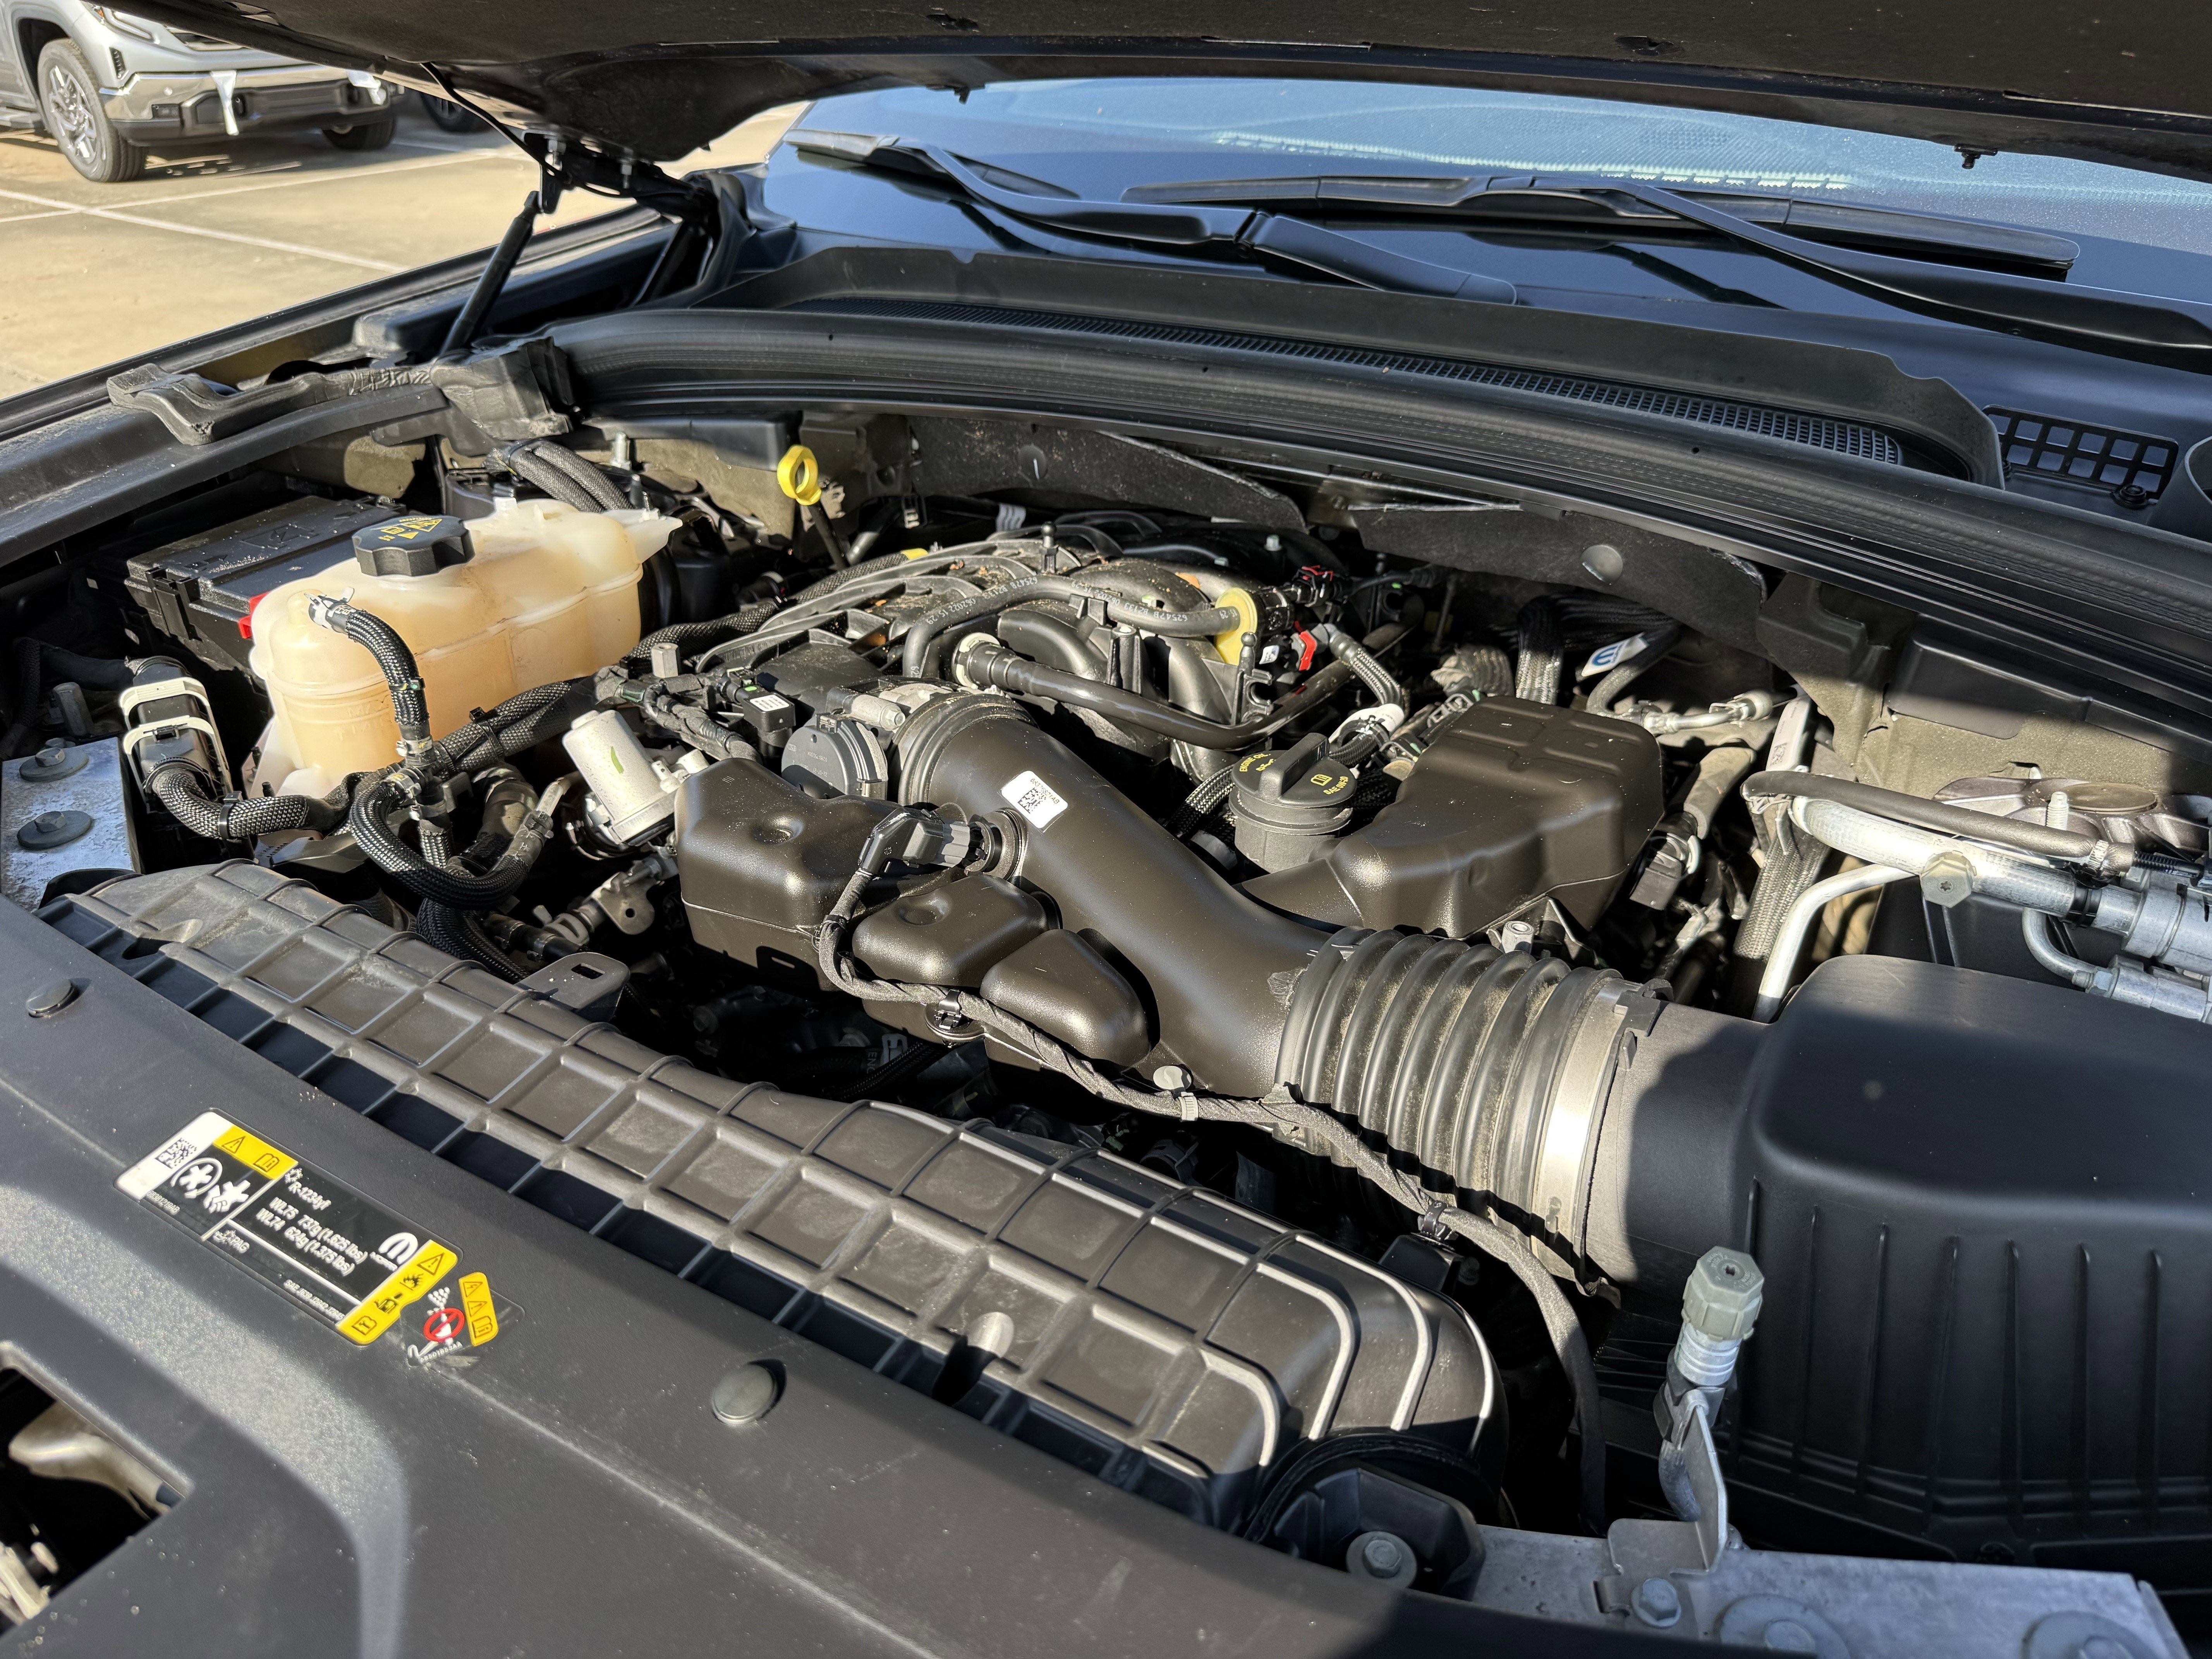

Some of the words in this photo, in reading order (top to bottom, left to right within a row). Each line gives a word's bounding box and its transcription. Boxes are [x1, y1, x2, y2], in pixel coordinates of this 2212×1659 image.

[1239, 757, 1256, 772] ENGINE
[1323, 786, 1341, 795] SAE
[288, 1181, 331, 1210] R-1234yf
[269, 1197, 299, 1219] WL75
[297, 1214, 322, 1237] 737g
[317, 1228, 350, 1251] (1.625
[345, 1243, 368, 1265] lbs)
[231, 1235, 250, 1254] PAG
[256, 1208, 286, 1231] WL74
[284, 1226, 309, 1249] 624g
[304, 1239, 338, 1264] (1.375
[332, 1255, 355, 1276] lbs)
[284, 1279, 300, 1293] SAE
